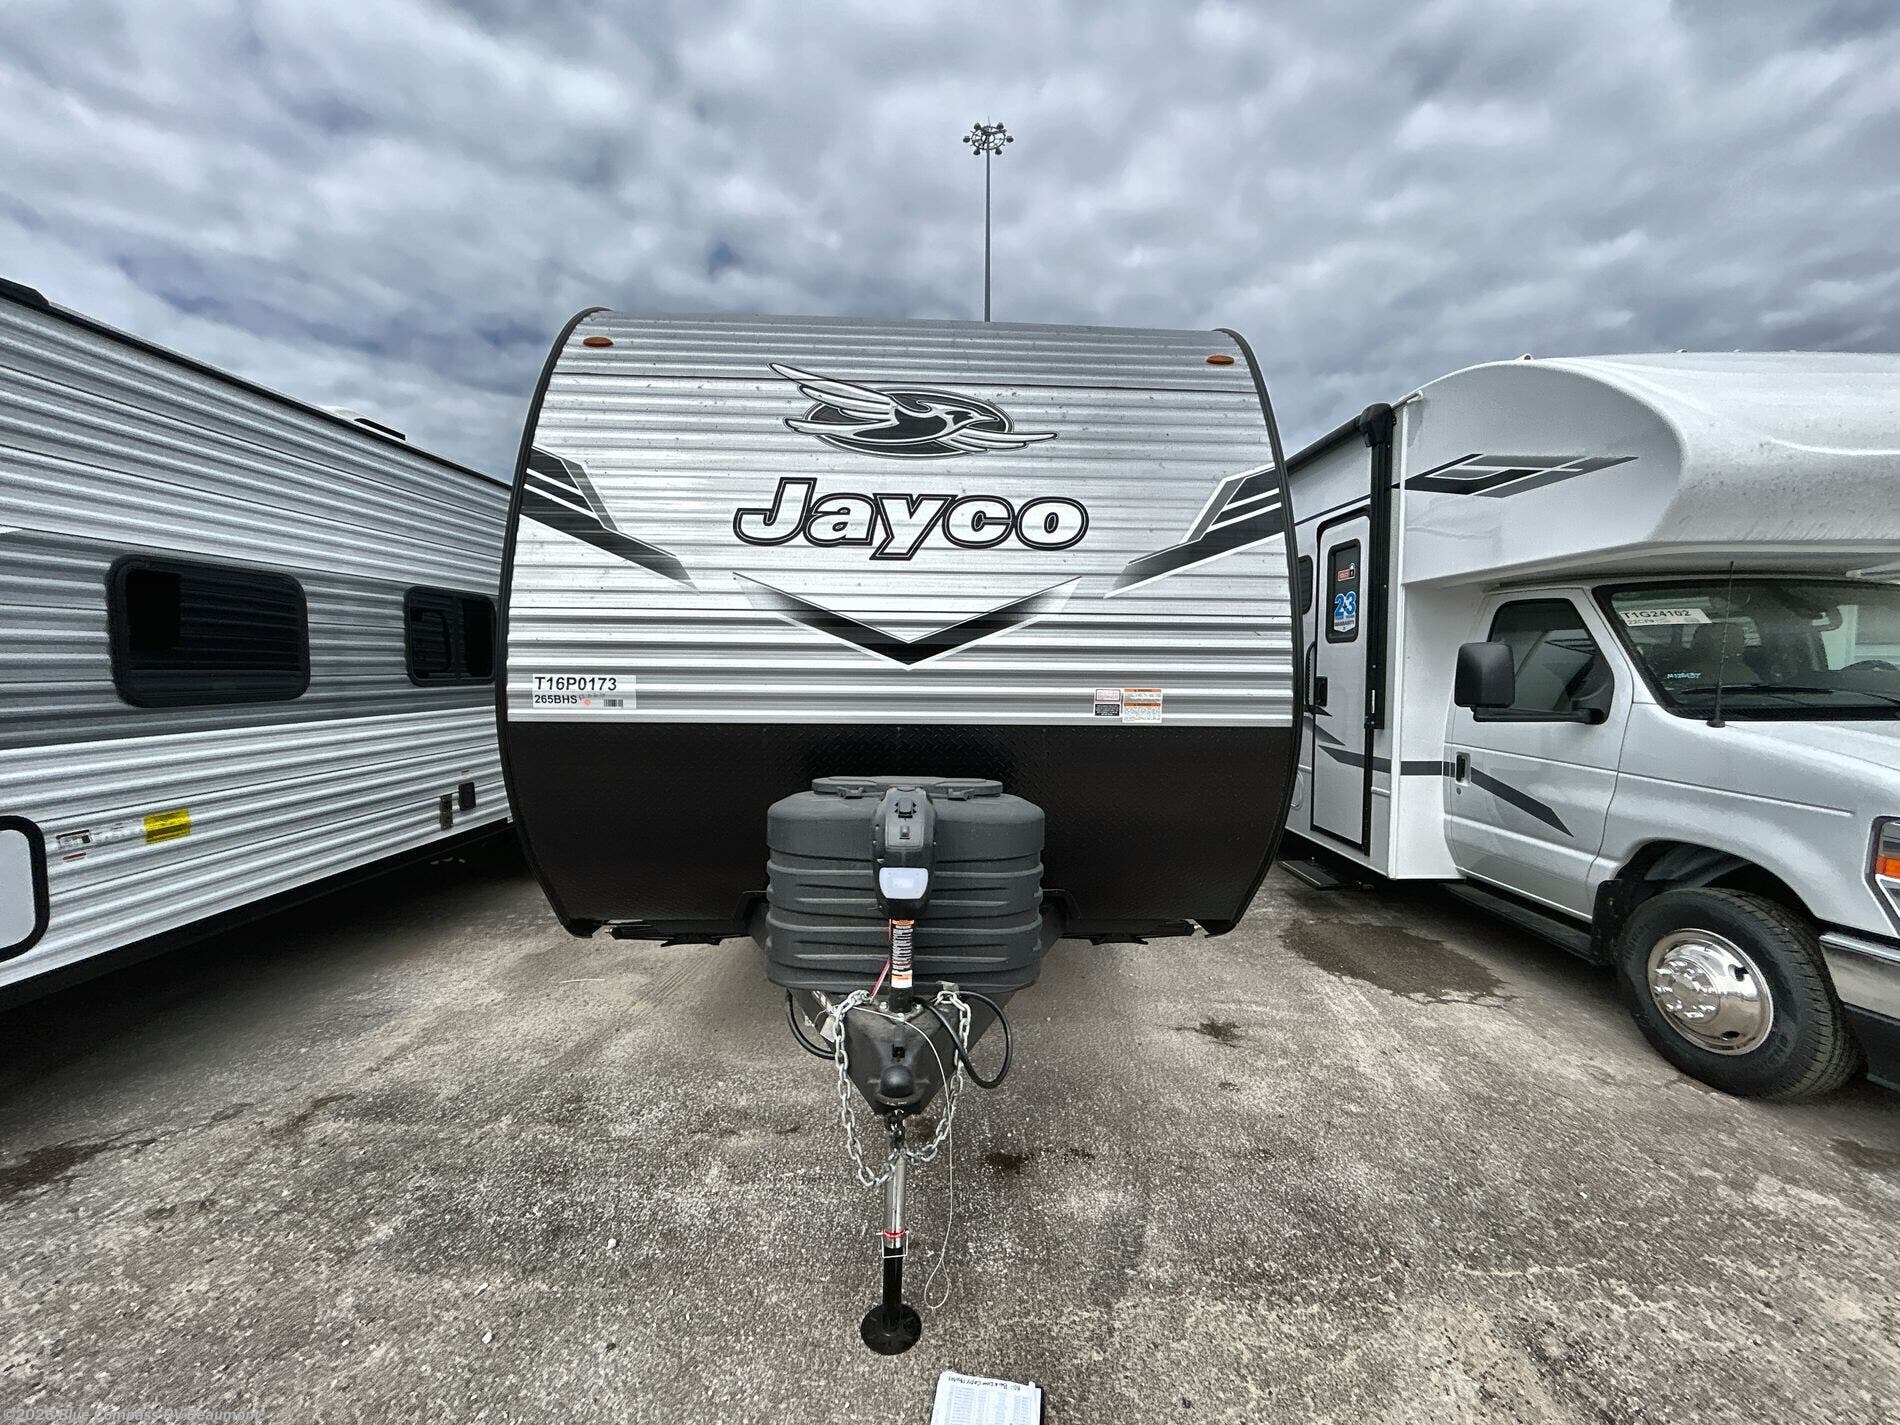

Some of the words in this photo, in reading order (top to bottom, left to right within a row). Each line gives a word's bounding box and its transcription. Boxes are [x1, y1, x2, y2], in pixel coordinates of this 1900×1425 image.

[733, 477, 1089, 561] Jayco
[534, 676, 617, 691] T16P0173
[534, 694, 578, 704] 265BHS
